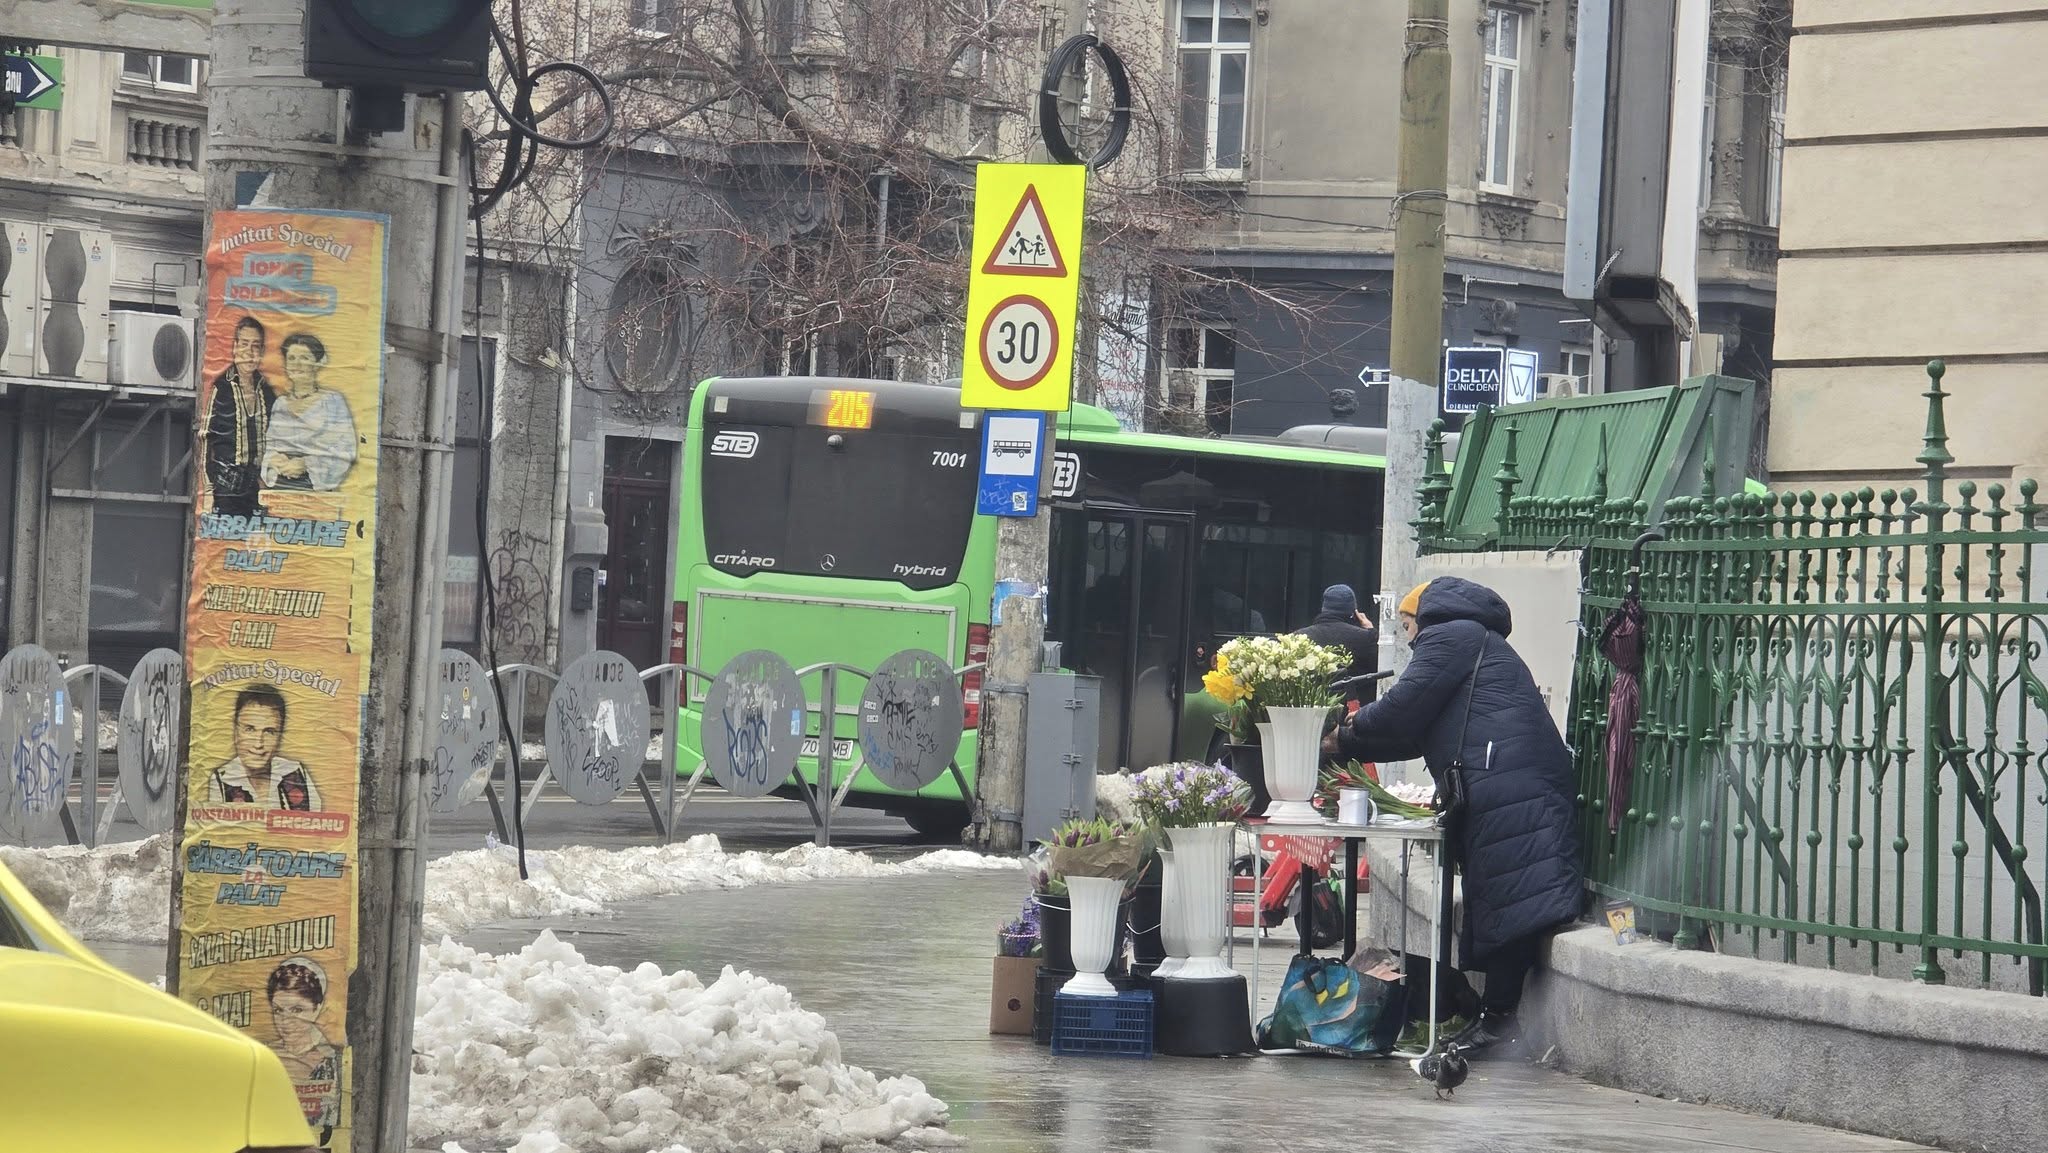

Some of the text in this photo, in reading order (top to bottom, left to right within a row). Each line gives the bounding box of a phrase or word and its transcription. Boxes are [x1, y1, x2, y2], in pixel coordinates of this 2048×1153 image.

[220, 223, 353, 262] Invitat Special
[997, 321, 1040, 364] 30
[1447, 368, 1500, 383] DELTA
[1447, 383, 1500, 392] CLINIC DENT
[826, 389, 871, 428] 205
[711, 433, 756, 456] STB
[931, 451, 967, 469] 7001
[1052, 457, 1078, 492] TB
[223, 548, 290, 574] PALAT
[713, 554, 776, 568] CITARO
[893, 563, 947, 577] hybrid
[203, 583, 326, 618] SALA PALATULUI
[229, 620, 277, 650] 6 MAI
[262, 658, 343, 698] Special
[802, 739, 818, 753] 70
[187, 840, 347, 879] SĂRBĂTOARE
[244, 871, 263, 884] LA
[216, 883, 287, 907] PALAT
[189, 915, 336, 970] SALA PALATULUI
[212, 990, 252, 1028] MAI
